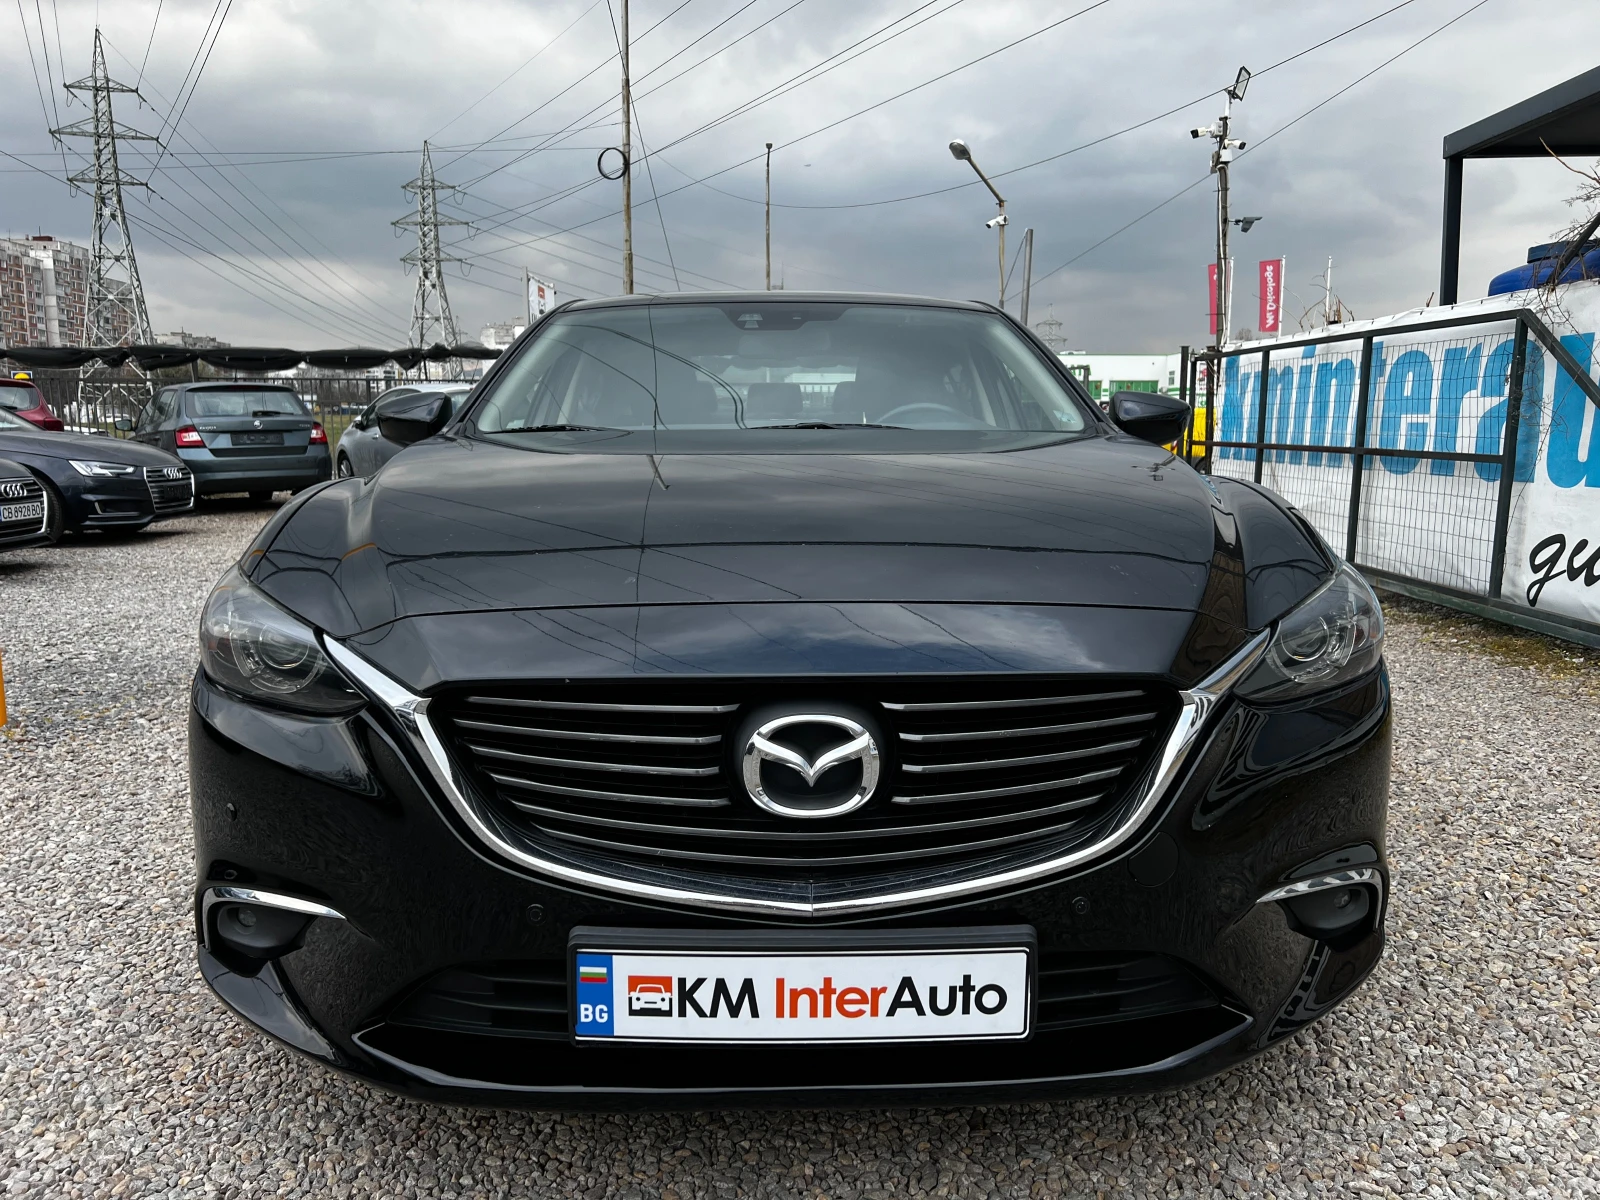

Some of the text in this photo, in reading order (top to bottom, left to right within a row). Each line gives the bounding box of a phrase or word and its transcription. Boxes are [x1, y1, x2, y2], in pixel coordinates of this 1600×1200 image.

[677, 974, 1008, 1019] KM InterAuto
[579, 1003, 609, 1023] BG
